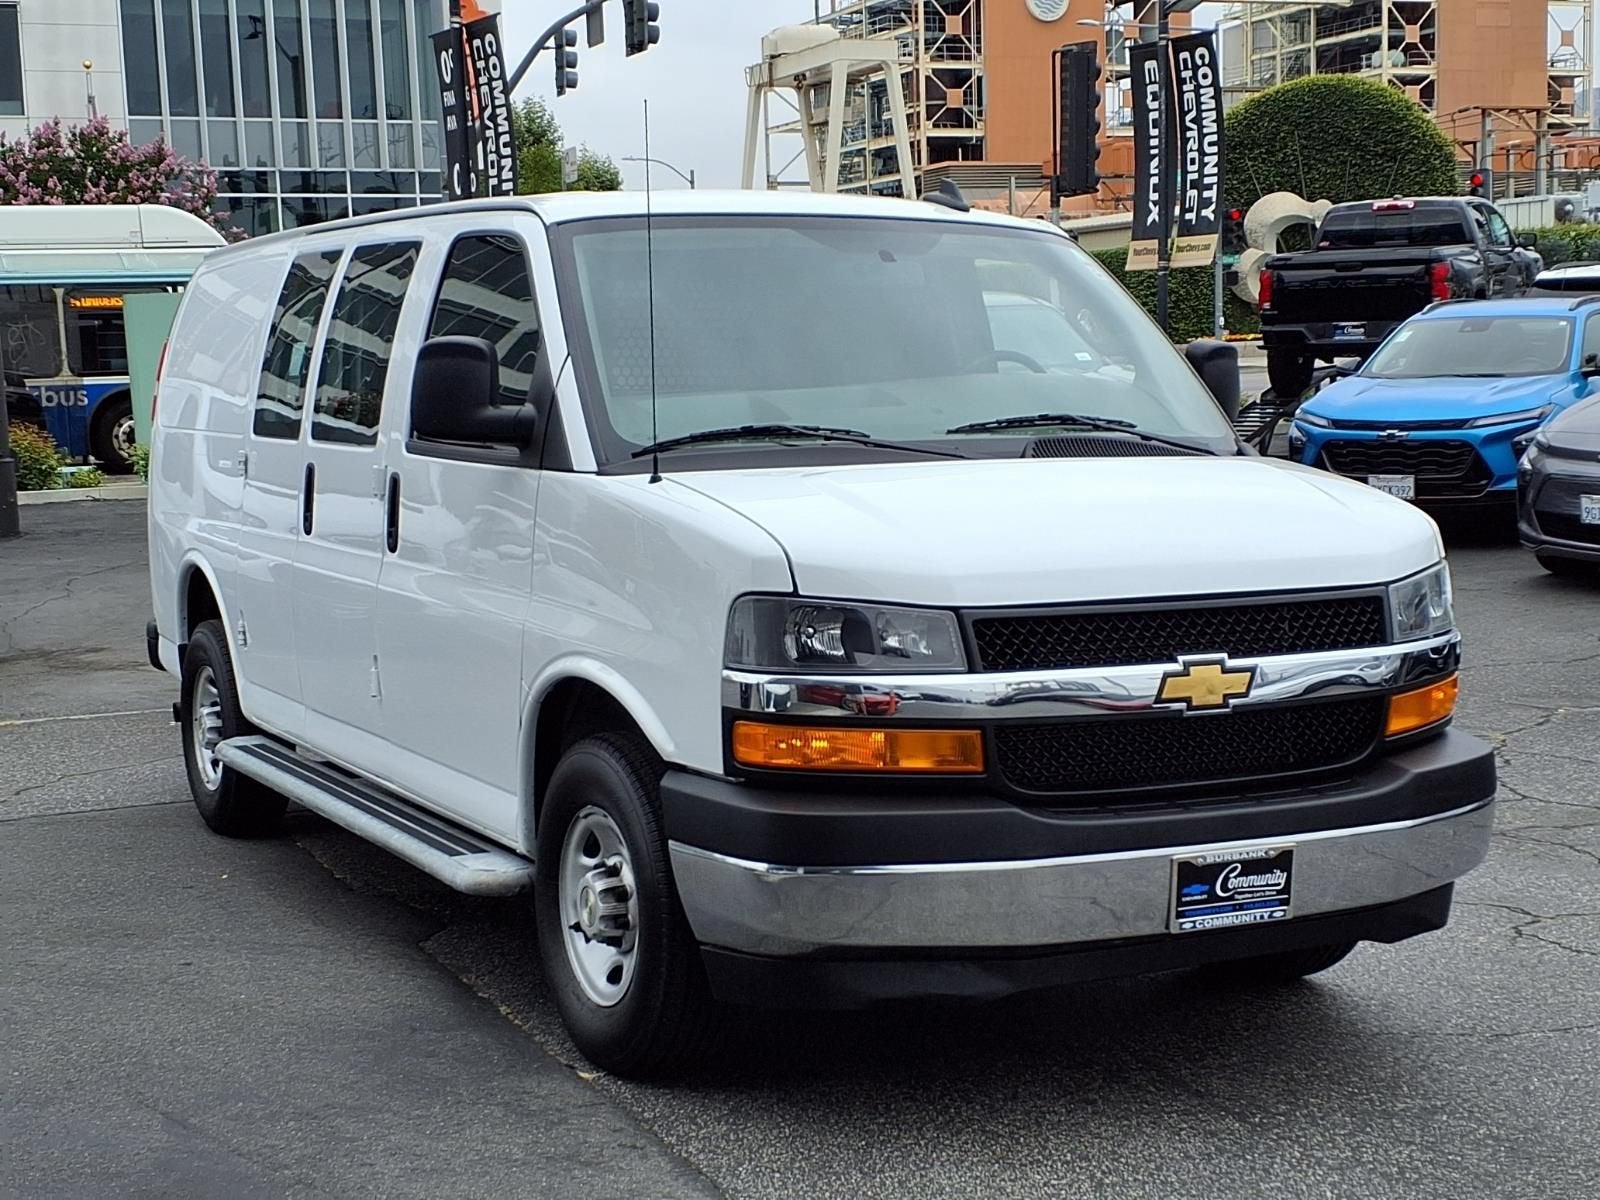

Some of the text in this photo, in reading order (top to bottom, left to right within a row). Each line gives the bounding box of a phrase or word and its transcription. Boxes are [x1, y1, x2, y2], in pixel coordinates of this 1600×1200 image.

[472, 38, 498, 198] CHEVROL
[484, 32, 514, 197] COMMUNI
[1178, 50, 1200, 226] CHEVROLET
[1194, 46, 1220, 222] COMMUNITY
[34, 387, 89, 407] bus
[1205, 849, 1266, 863] BURBANK
[1215, 863, 1288, 898] Community
[1195, 911, 1271, 929] COMMUNITY
